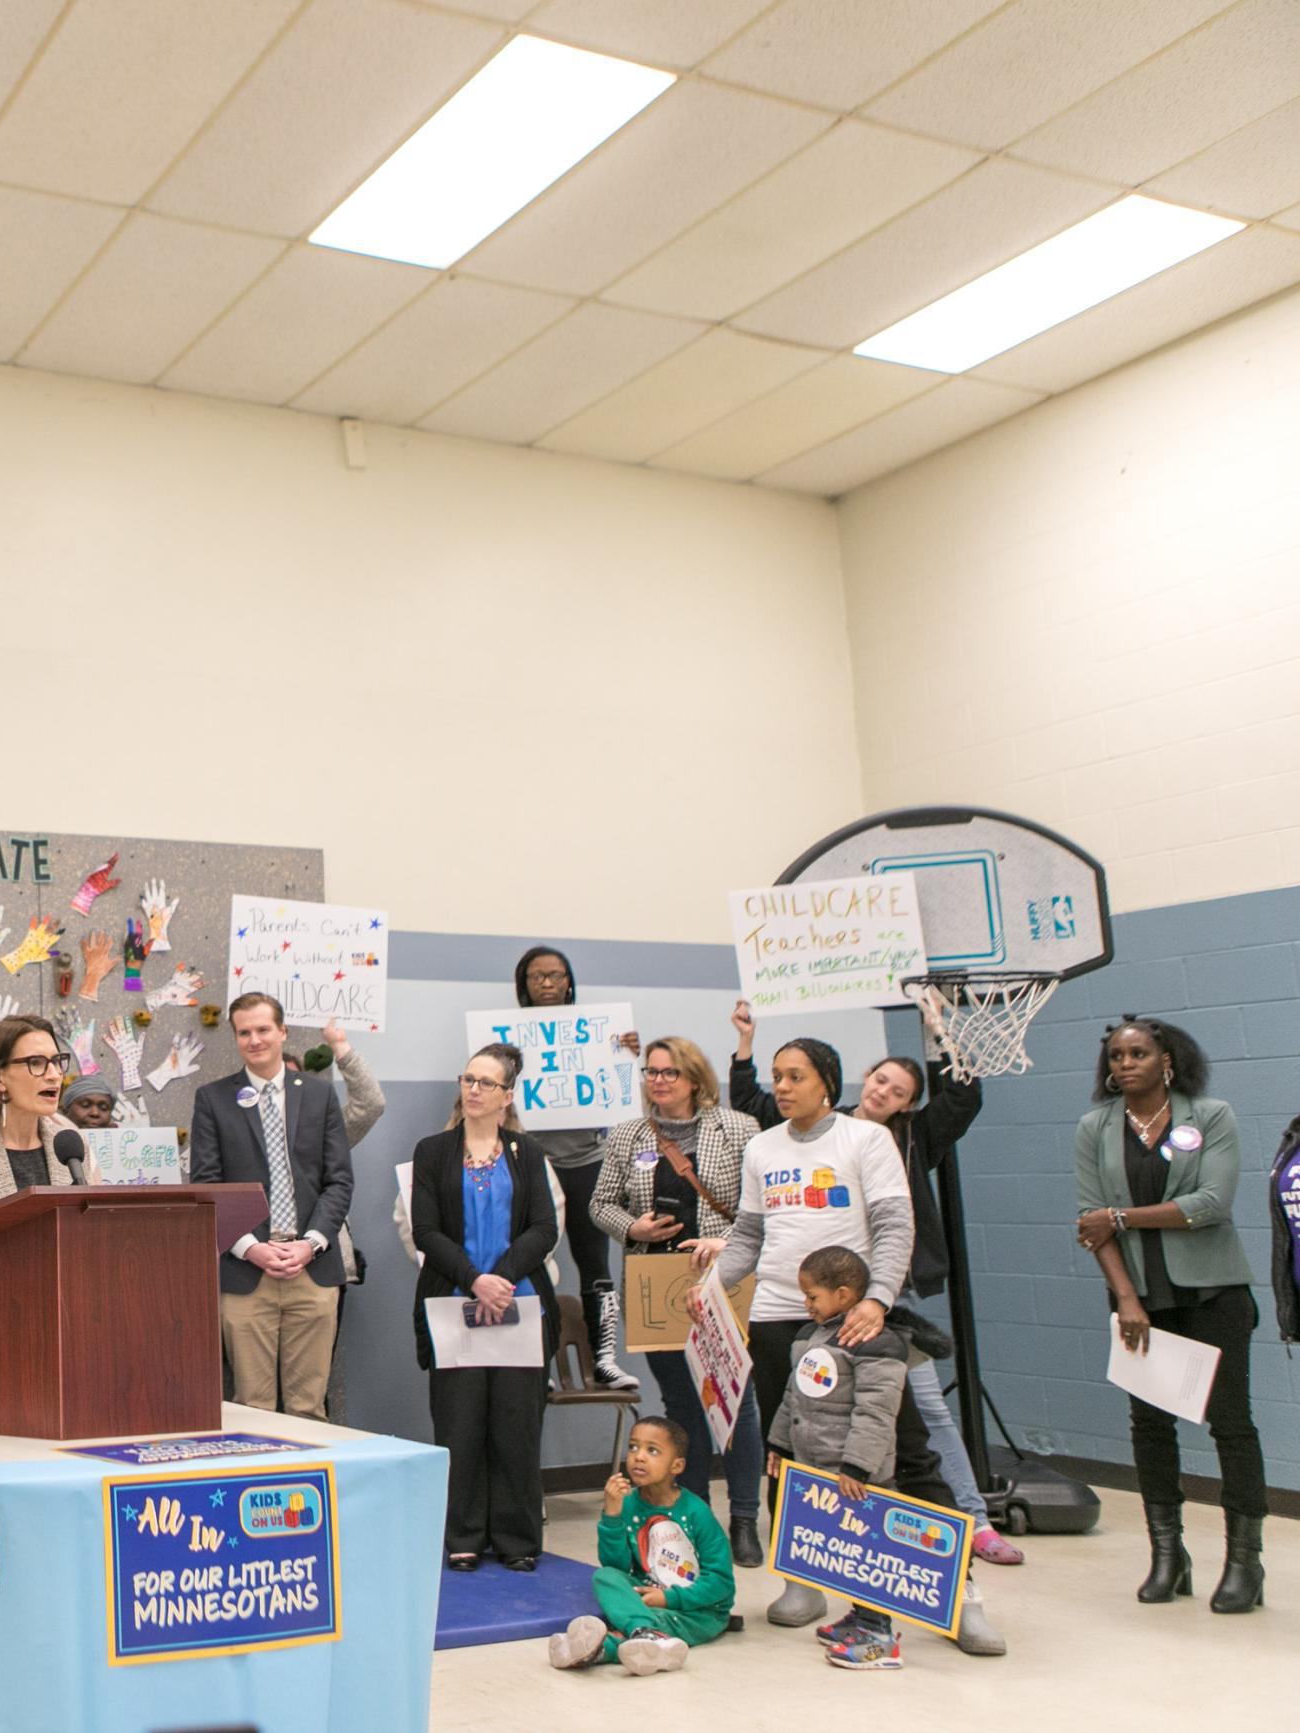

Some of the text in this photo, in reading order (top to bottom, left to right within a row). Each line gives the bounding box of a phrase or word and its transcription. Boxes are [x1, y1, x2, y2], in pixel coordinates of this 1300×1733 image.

[745, 884, 909, 919] CHILDCARE
[249, 907, 364, 937] Parents Can't
[245, 944, 281, 963] Work
[492, 1016, 609, 1048] INVEST
[541, 1048, 585, 1072] IN
[120, 1130, 177, 1169] Care
[764, 1168, 801, 1187] KIDS
[250, 1492, 282, 1508] KIDS
[251, 1506, 282, 1518] COUNT
[803, 1484, 870, 1537] All In
[137, 1496, 225, 1552] All In
[252, 1518, 268, 1528] ON
[893, 1512, 921, 1528] KIDS
[661, 1548, 681, 1562] KIDS
[793, 1525, 943, 1588] FOR OUR LITTLEST
[133, 1556, 317, 1597] FOR OUR LITTLEST
[790, 1542, 940, 1608] MINNESOTANS
[134, 1582, 319, 1630] MINNESOTANS
